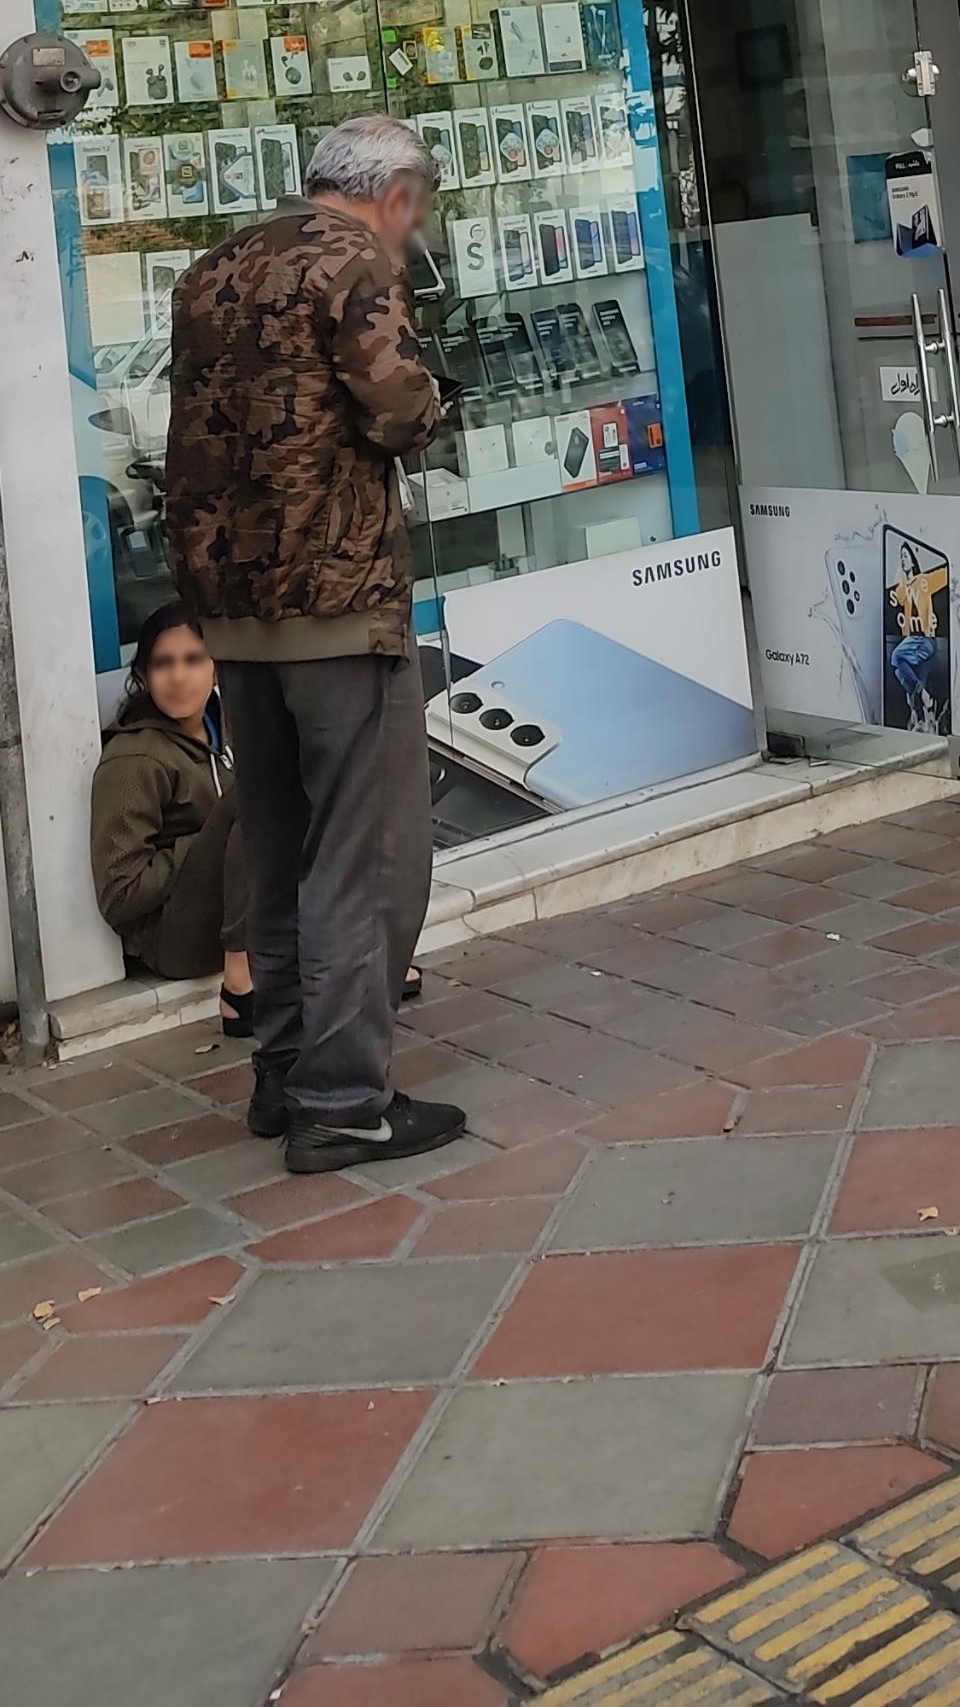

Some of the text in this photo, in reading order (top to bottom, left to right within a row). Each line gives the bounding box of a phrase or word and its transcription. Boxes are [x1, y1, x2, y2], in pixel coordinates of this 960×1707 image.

[750, 503, 791, 518] SAMSUNG
[631, 549, 723, 588] SAMSUNG
[765, 648, 811, 667] Galaxy A72
